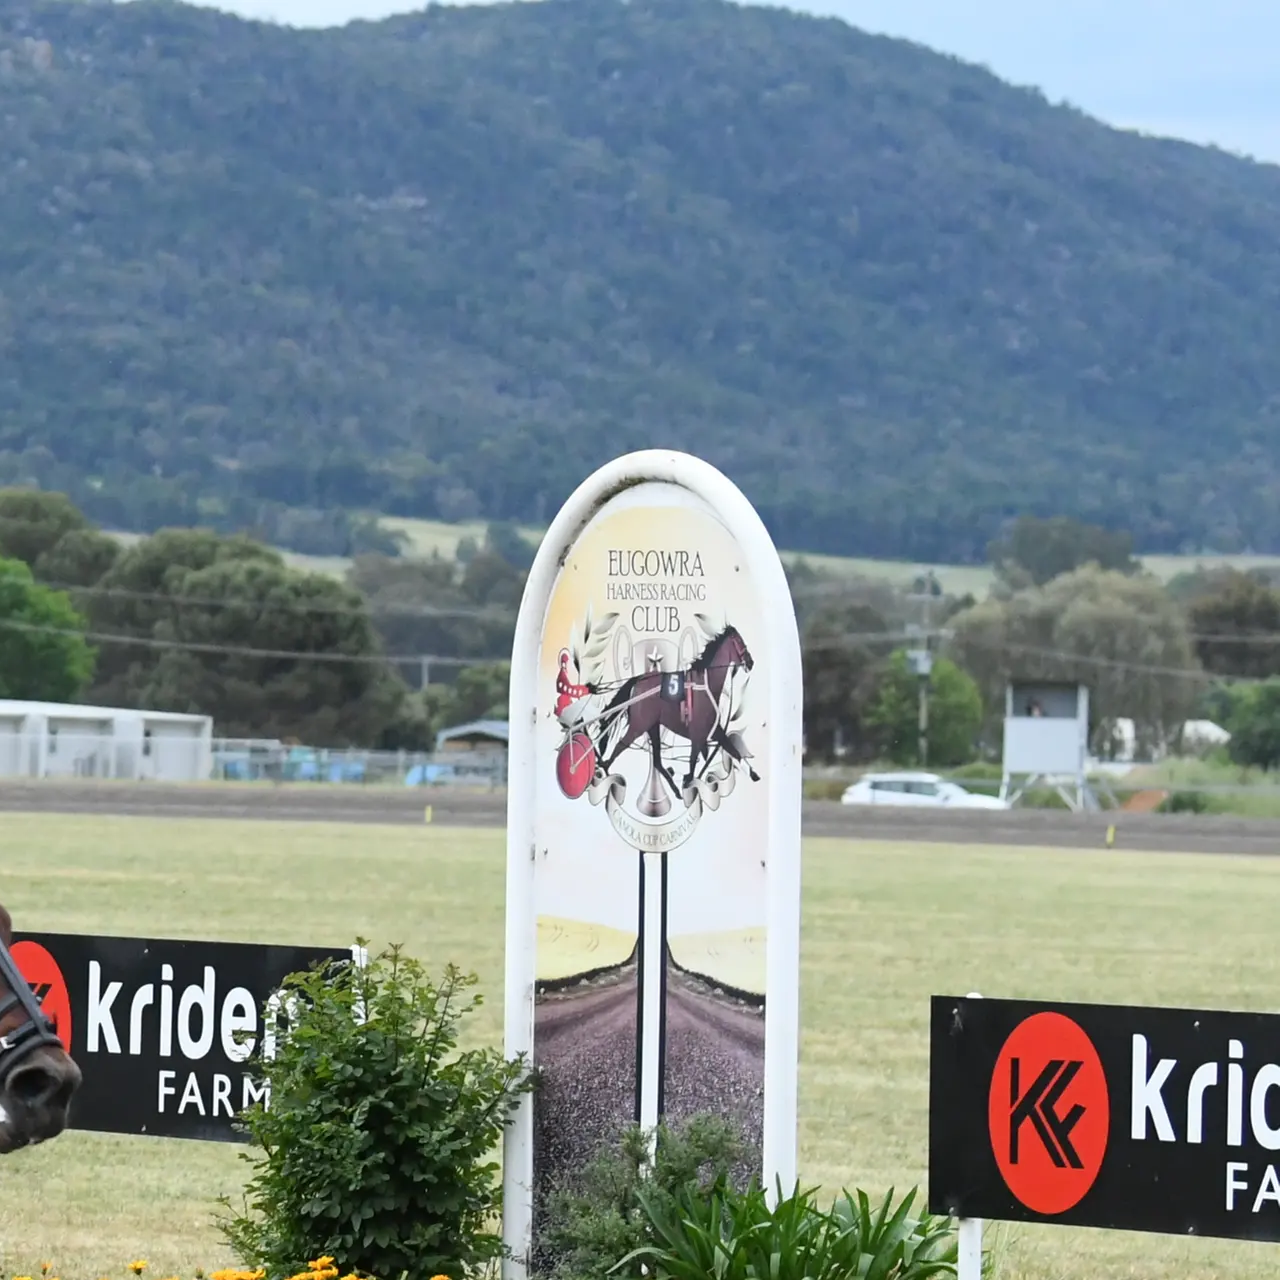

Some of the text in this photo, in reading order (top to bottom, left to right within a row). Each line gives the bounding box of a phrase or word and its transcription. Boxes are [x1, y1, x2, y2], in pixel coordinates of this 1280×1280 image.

[608, 549, 705, 577] EUGOWRA
[606, 583, 706, 601] HARNESS RACING
[631, 605, 681, 632] CLUB
[668, 674, 679, 696] 5
[158, 1070, 271, 1118] FARM
